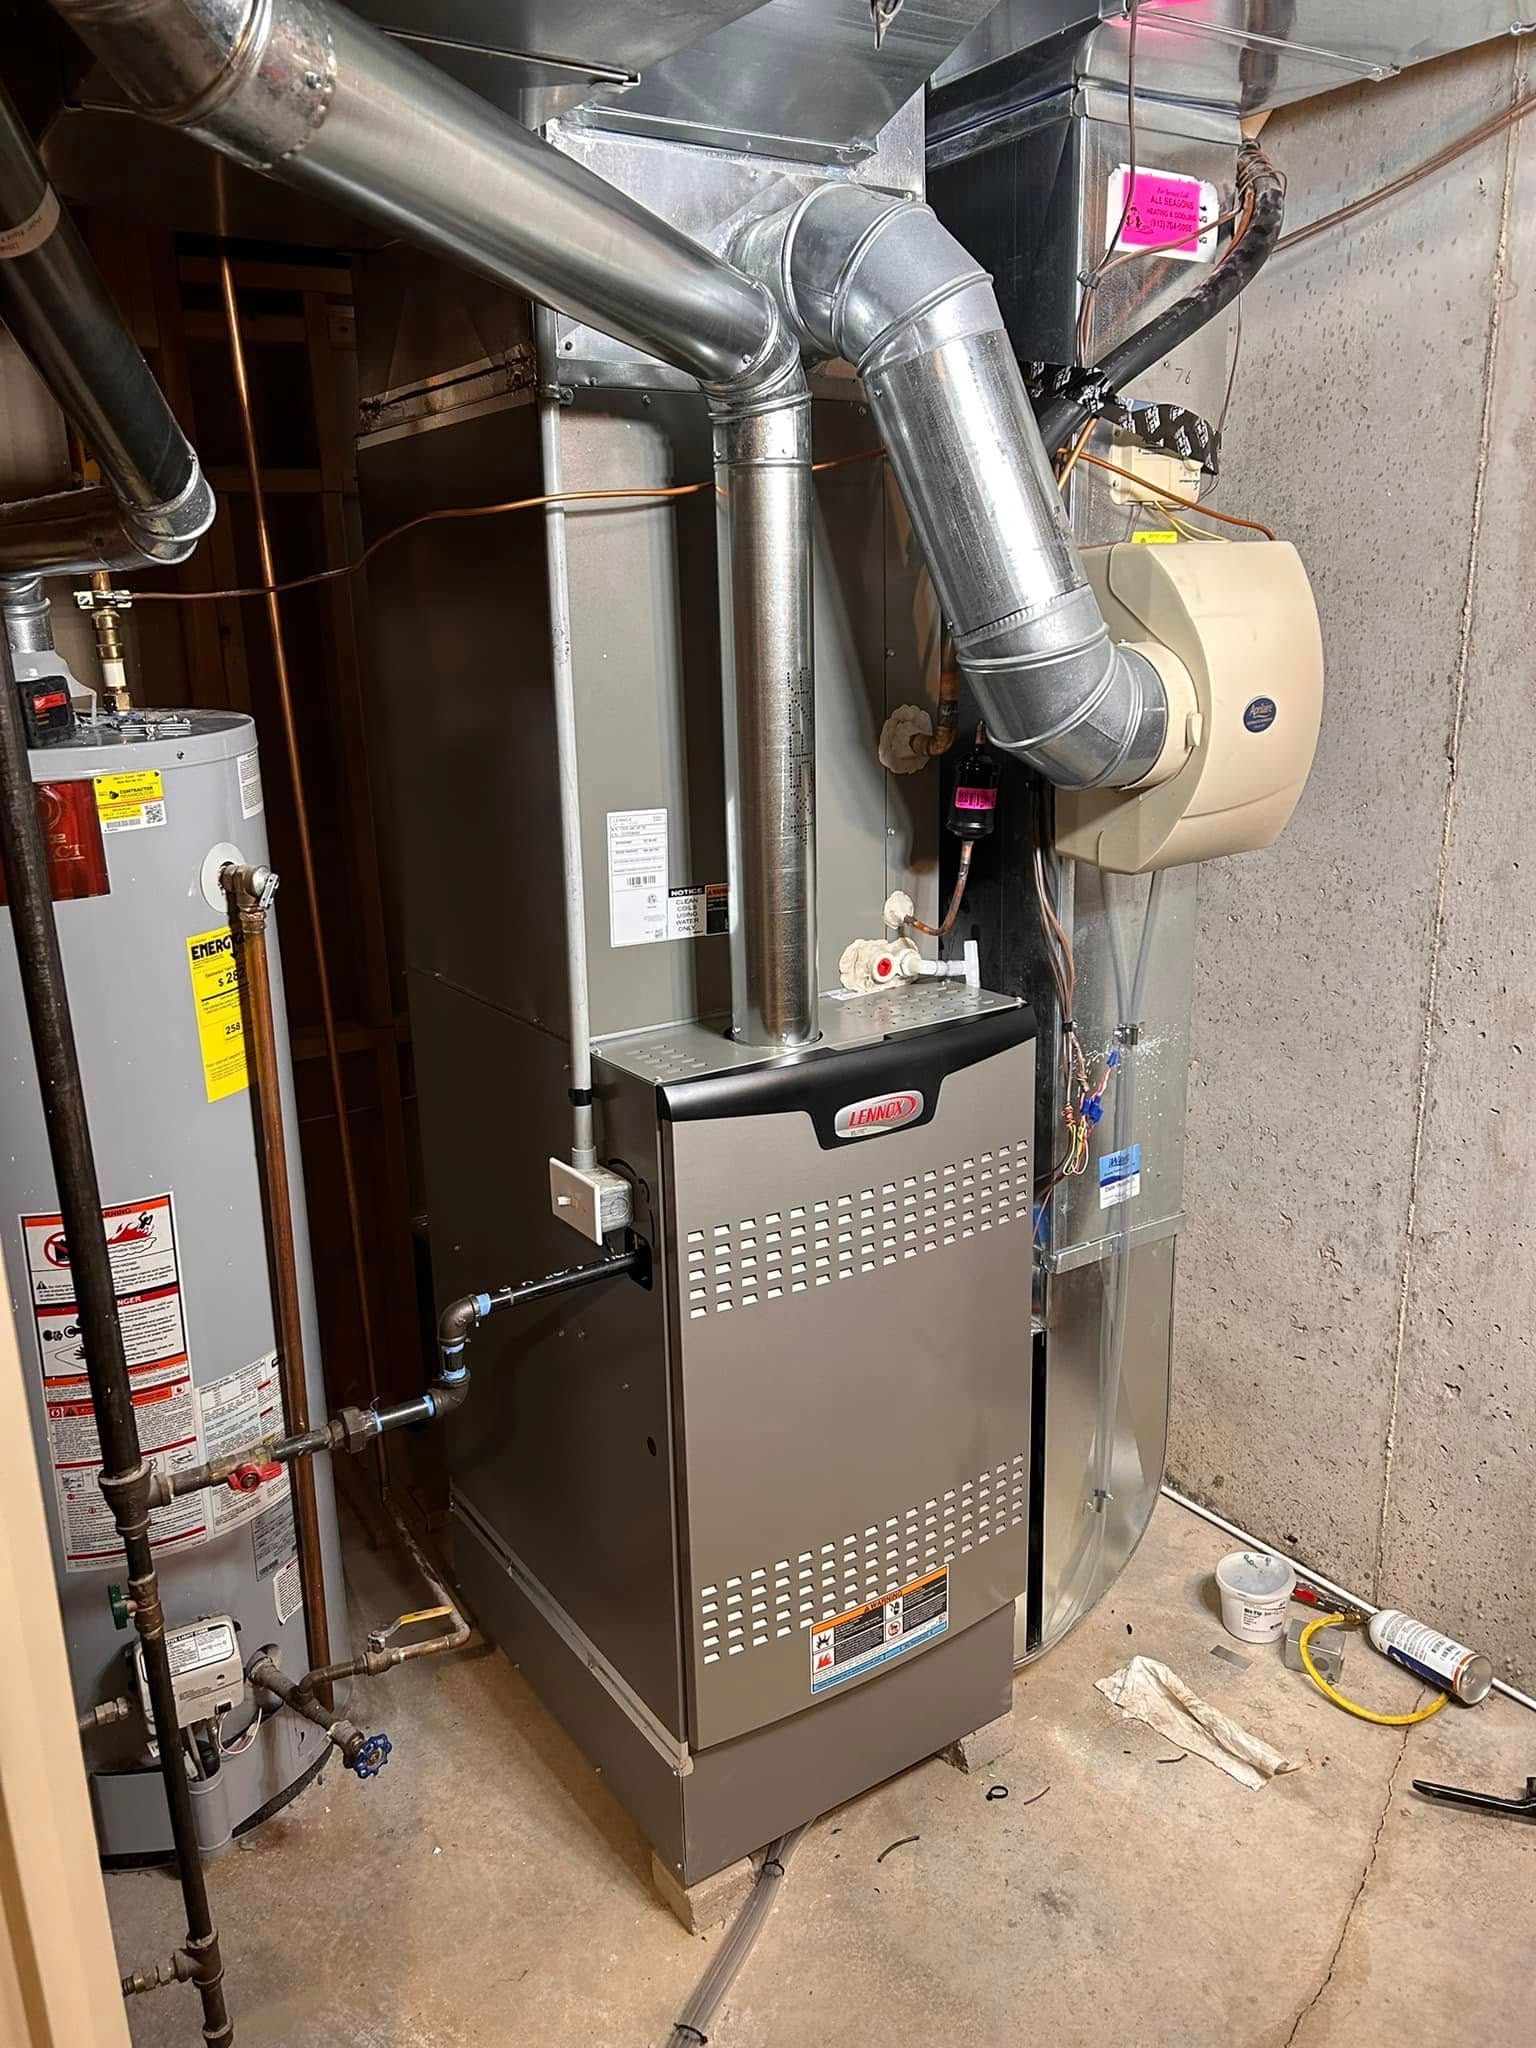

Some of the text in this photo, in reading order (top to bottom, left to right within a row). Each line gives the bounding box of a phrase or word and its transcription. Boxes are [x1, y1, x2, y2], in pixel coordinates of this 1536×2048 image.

[1151, 195, 1194, 209] ALL SEASONS
[1175, 367, 1191, 385] 76
[671, 887, 703, 897] NOTICE
[676, 897, 698, 905] CLEAN
[676, 904, 698, 912] COILS
[676, 911, 698, 919] USING
[676, 918, 699, 926] WATER
[848, 1100, 906, 1128] LENNOX
[117, 1296, 142, 1306] NGER
[870, 1590, 903, 1610] WARNING
